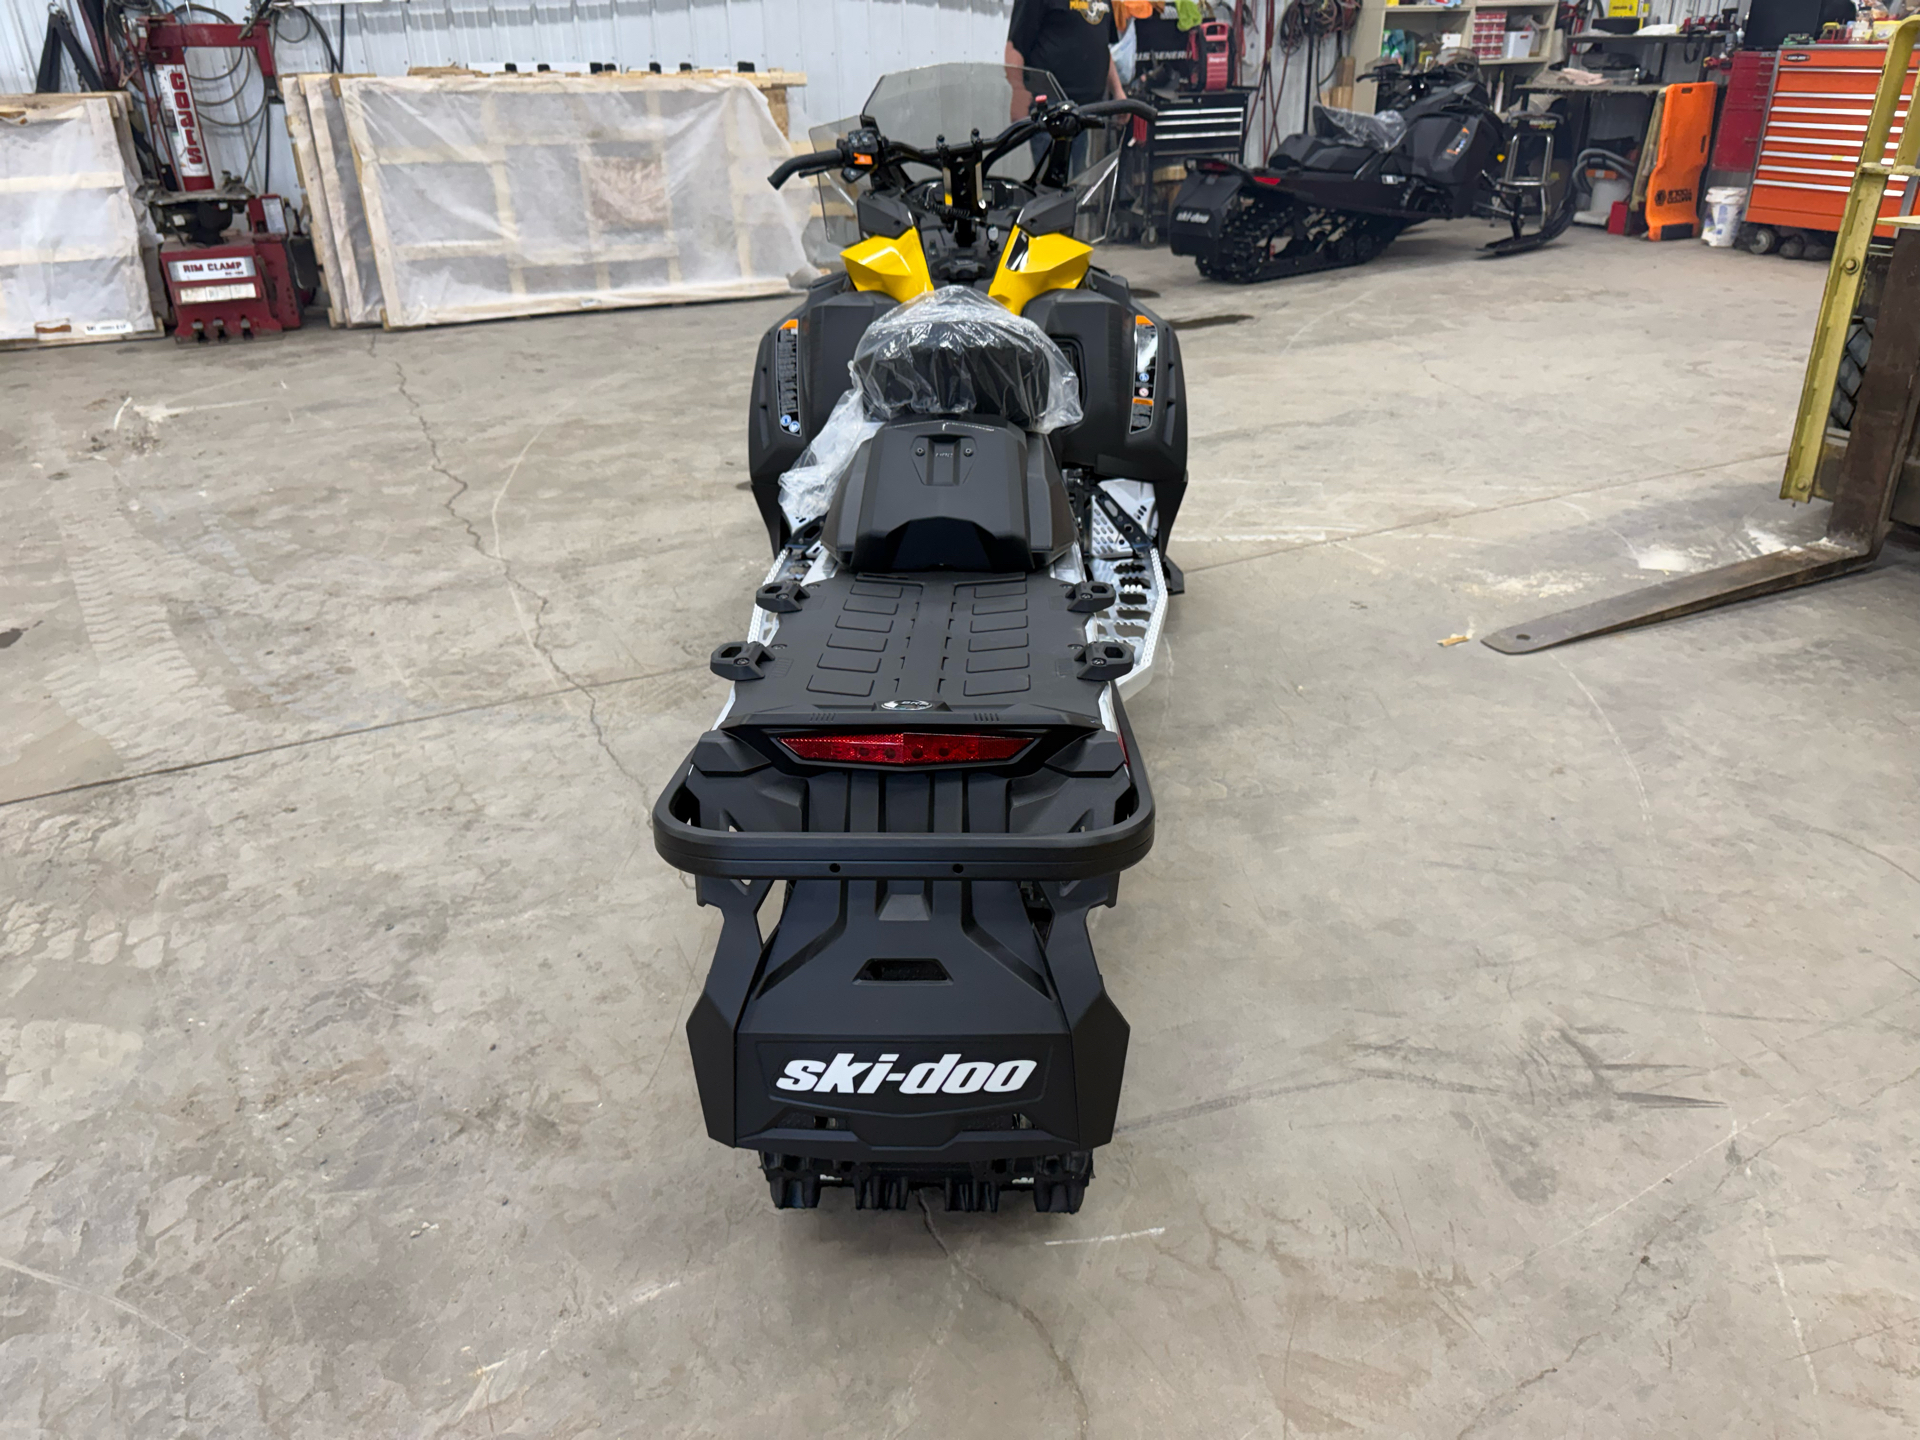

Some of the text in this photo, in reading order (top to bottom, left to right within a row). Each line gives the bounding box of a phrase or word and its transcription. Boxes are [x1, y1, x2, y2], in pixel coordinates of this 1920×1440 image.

[182, 261, 242, 273] RIM CLAMP
[775, 1053, 1038, 1095] ski-doo
